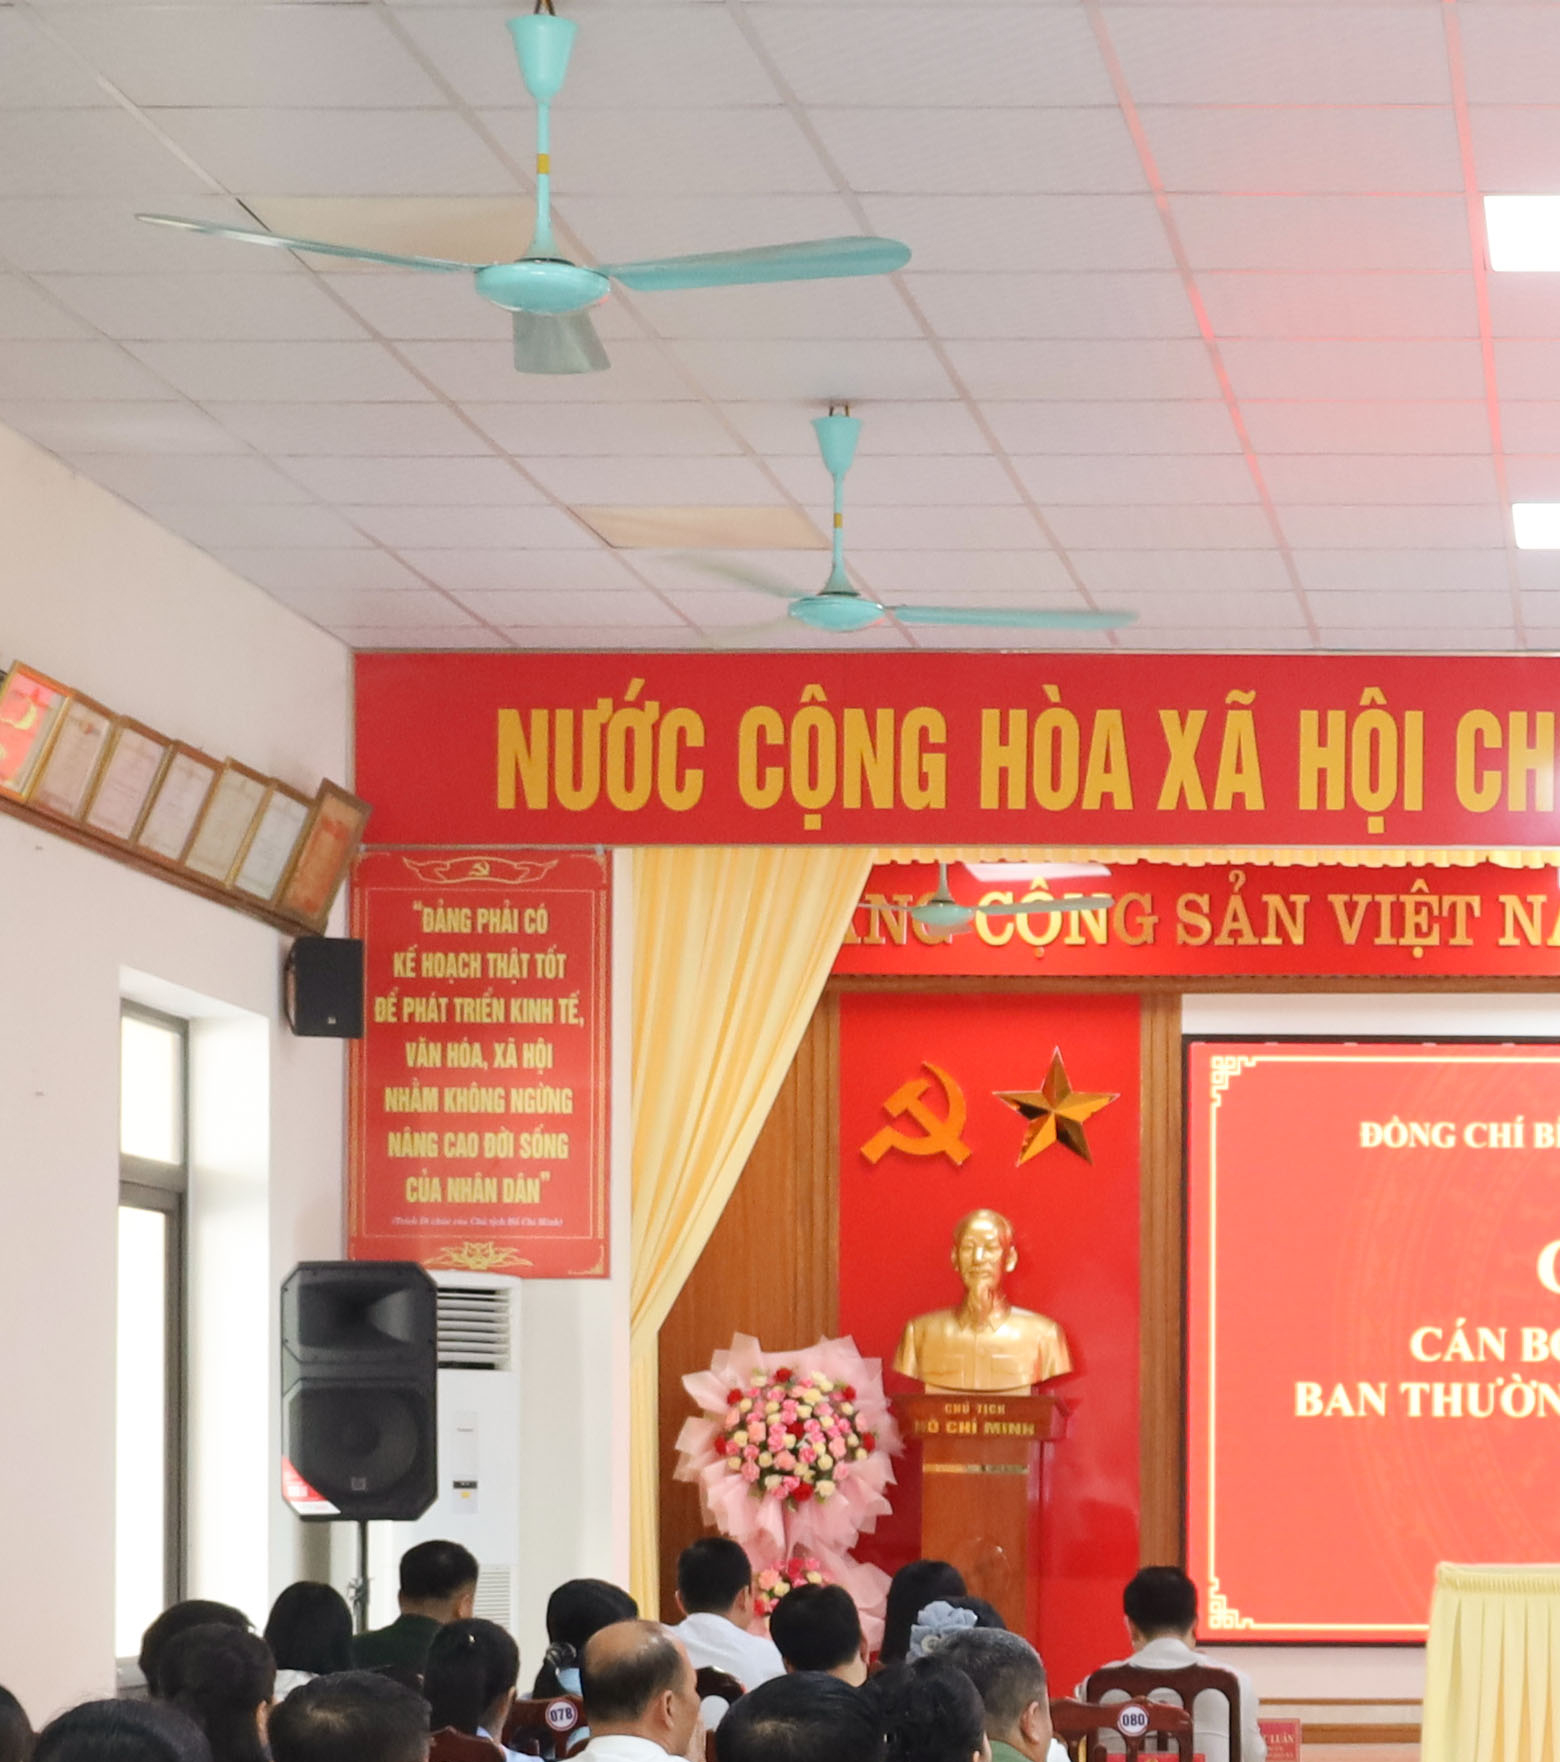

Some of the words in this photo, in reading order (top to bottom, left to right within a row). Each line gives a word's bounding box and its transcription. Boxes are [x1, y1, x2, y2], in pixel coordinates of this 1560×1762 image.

[497, 678, 705, 811] NƯỚC
[738, 684, 947, 830] CỘNG
[980, 684, 1133, 811] HÒA
[1158, 690, 1265, 810] XÃ
[1298, 687, 1424, 834] HỘI
[477, 899, 519, 934] PHẢI
[523, 903, 548, 934] CÓ
[974, 876, 1158, 958] CỘNG
[1176, 870, 1310, 946] SẢN
[1329, 879, 1481, 958] VIỆT
[393, 944, 418, 978] KẾ
[421, 952, 481, 984] HOẠCH
[487, 947, 531, 984] THẬT
[535, 944, 567, 978] TỐT
[374, 986, 398, 1023] ĐỂ
[403, 991, 448, 1023] PHÁT
[453, 986, 506, 1023] TRIỂN
[510, 997, 554, 1023] KINH
[558, 989, 585, 1028] TẾ,
[405, 1036, 441, 1068] VĂN
[446, 1036, 489, 1070] HÓA,
[493, 1037, 518, 1069] XÃ
[522, 1037, 553, 1075] HỘI
[385, 1077, 439, 1113] NHẰM
[444, 1081, 506, 1113] KHÔNG
[510, 1081, 573, 1114] NGỪNG
[388, 1126, 439, 1157] NÂNG
[443, 1132, 480, 1159] CAO
[484, 1125, 515, 1159] ĐỜI
[519, 1123, 569, 1159] SỐNG
[1359, 1115, 1456, 1150] ĐỒNG
[1463, 1115, 1525, 1150] CHÍ
[405, 1168, 442, 1203] CỦA
[446, 1172, 498, 1204] NHÂN
[1408, 1323, 1508, 1364] CÁN
[1294, 1381, 1389, 1418] BAN
[984, 1421, 1036, 1435] MINH
[550, 1706, 574, 1723] 078
[1122, 1713, 1146, 1726] 080
